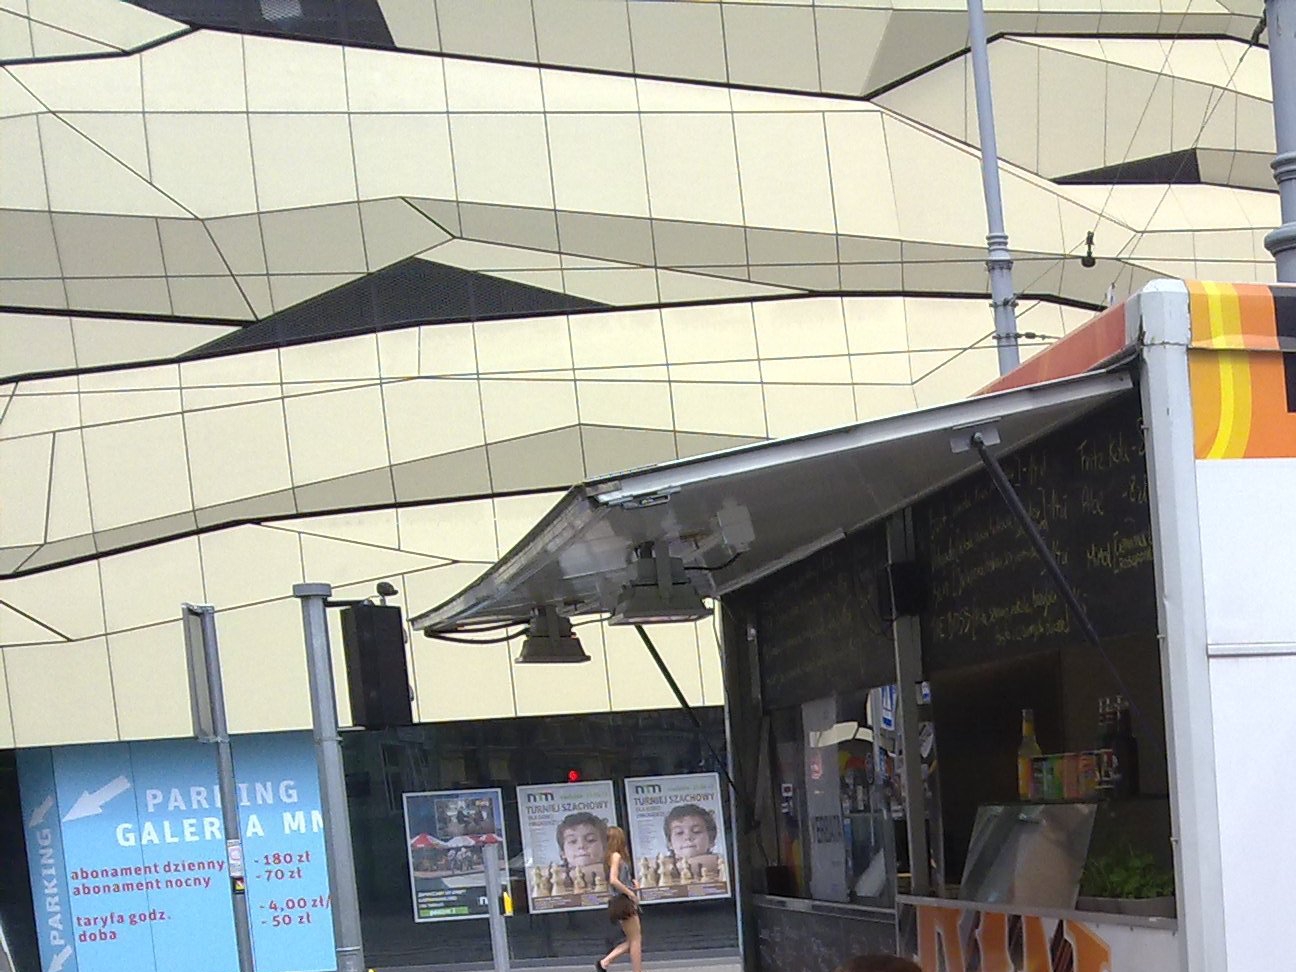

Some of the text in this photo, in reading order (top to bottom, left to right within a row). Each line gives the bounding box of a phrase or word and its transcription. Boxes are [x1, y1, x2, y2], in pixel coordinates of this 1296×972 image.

[525, 801, 609, 816] TURNIEJ SZACHOWY
[633, 792, 716, 807] TURNIEJ SZACHOWY
[115, 811, 265, 847] GALERA
[71, 862, 160, 881] abonament
[163, 857, 226, 875] dzienny
[262, 851, 293, 867] 180
[297, 851, 312, 864] zł
[37, 828, 66, 946] PARKING
[72, 877, 161, 897] abonament
[165, 874, 212, 891] nocny
[264, 868, 286, 882] 70
[288, 867, 303, 880] zł
[76, 911, 126, 928] taryfa
[128, 909, 172, 926] godz.
[268, 897, 307, 913] 4,00
[78, 929, 118, 944] doba
[272, 913, 293, 927] 50
[297, 912, 313, 925] zł
